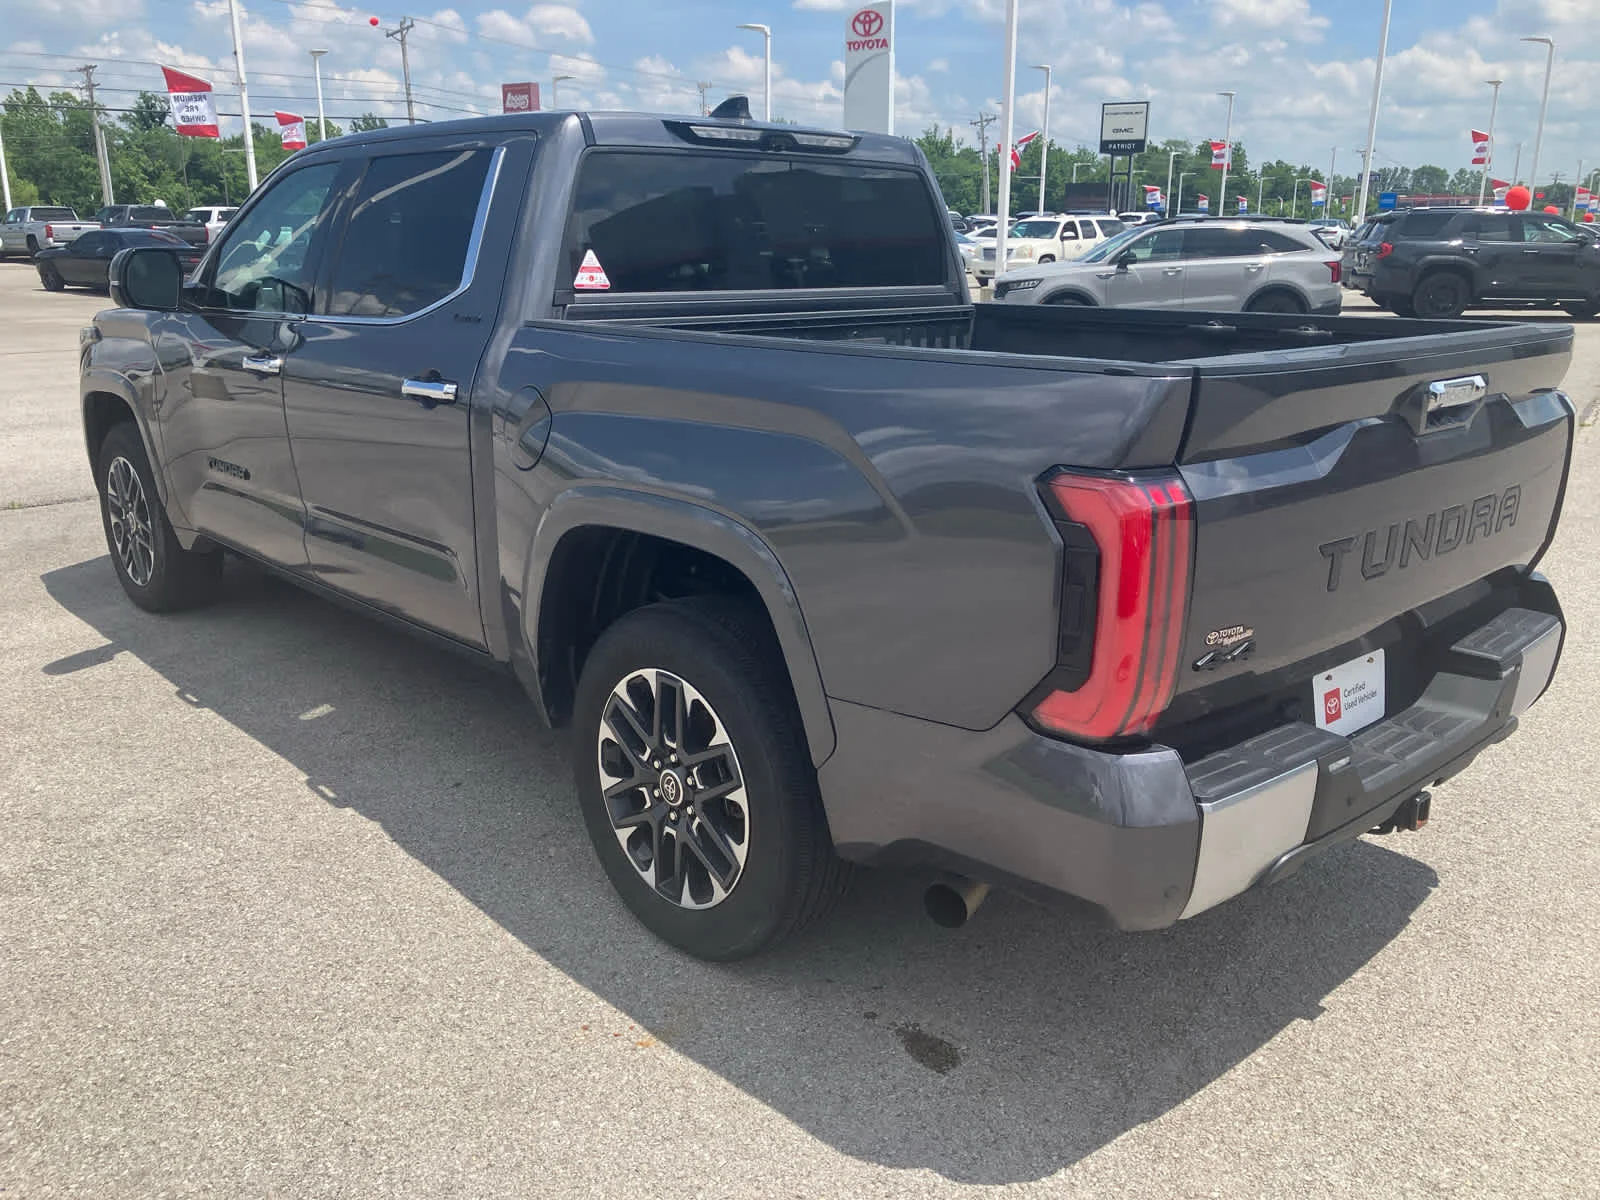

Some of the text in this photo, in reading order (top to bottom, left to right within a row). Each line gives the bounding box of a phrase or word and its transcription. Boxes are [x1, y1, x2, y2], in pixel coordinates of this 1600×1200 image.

[847, 38, 889, 52] TOYOTA
[1319, 484, 1522, 592] TUNDRA
[1219, 625, 1244, 638] TOYOTA
[1343, 681, 1366, 698] Certified
[1344, 701, 1358, 711] Used
